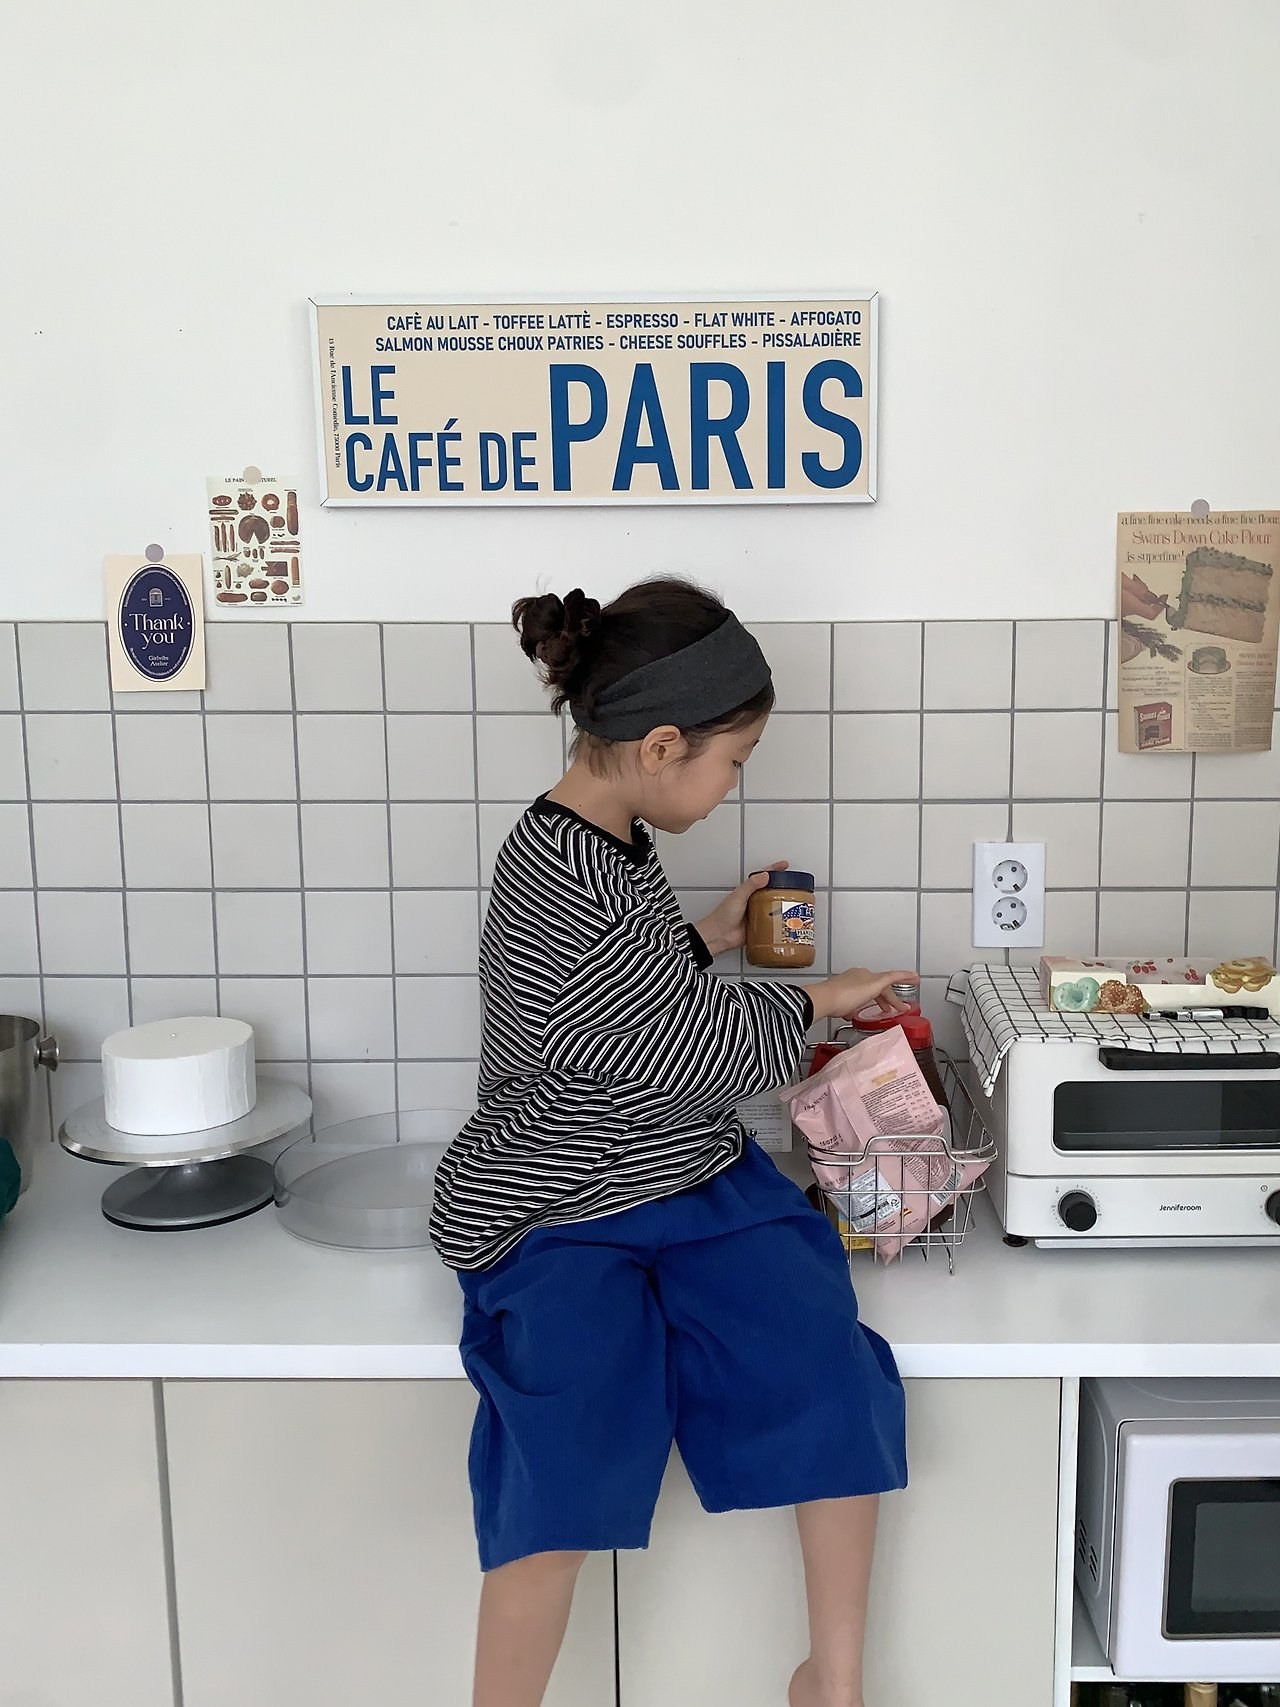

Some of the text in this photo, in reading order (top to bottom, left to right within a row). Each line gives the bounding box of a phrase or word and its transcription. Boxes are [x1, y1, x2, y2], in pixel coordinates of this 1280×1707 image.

[387, 312, 422, 331] CAFÈ
[426, 316, 444, 330] AU
[449, 315, 479, 330] LAIT
[493, 314, 545, 330] TOFFEE
[549, 310, 591, 330] LATTÈ
[606, 313, 679, 329] ESPRESSO
[694, 312, 728, 328] FLAT
[731, 312, 775, 327] WHITE
[790, 311, 862, 327] AFFOGATO
[375, 336, 433, 352] SALMON
[437, 336, 494, 351] MOUSSE
[499, 336, 544, 351] CHOUX
[548, 335, 604, 351] PATRIES
[619, 334, 673, 350] CHEESE
[677, 333, 747, 349] SOUFFLES
[762, 328, 862, 348] PISSALADIÈRE
[341, 364, 399, 426] LE
[329, 360, 336, 369] de
[334, 452, 342, 469] Paris
[345, 359, 864, 492] CAFÉ DE PARIS
[1165, 513, 1186, 525] cake
[1132, 529, 1272, 545] Swans Down Cake Flour
[1127, 551, 1135, 562] is
[128, 613, 185, 631] Thank
[141, 632, 175, 650] you
[1159, 1203, 1202, 1211] Jenniferoom
